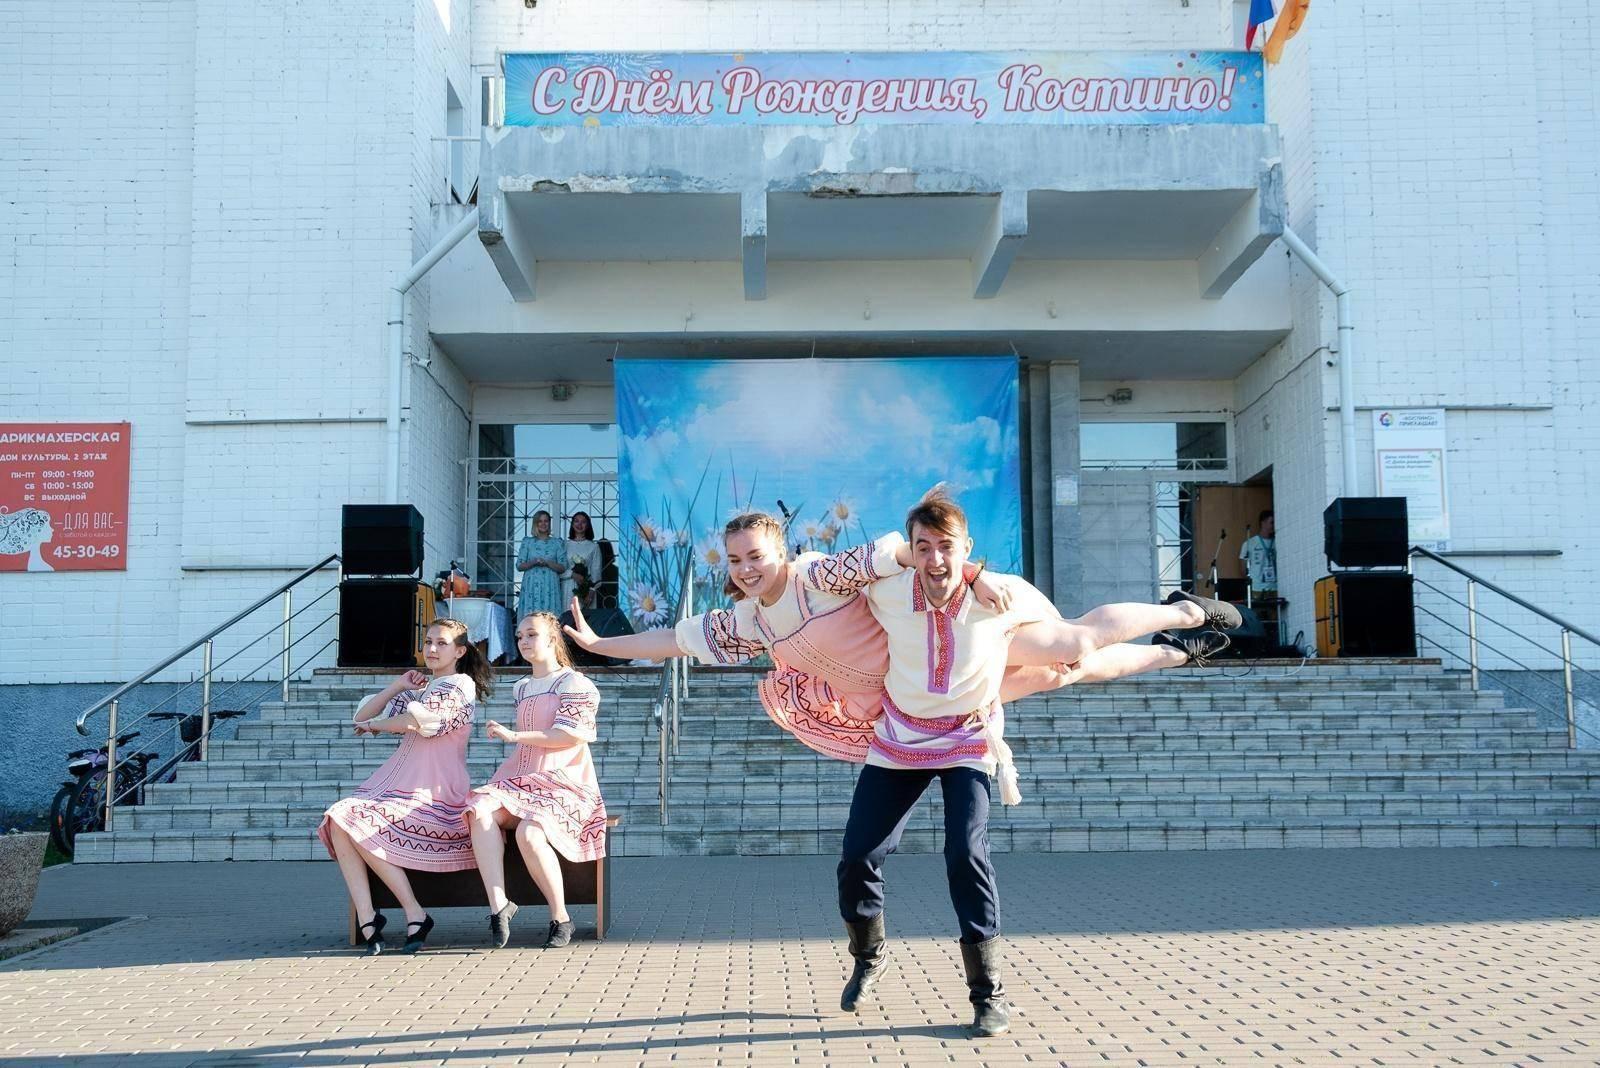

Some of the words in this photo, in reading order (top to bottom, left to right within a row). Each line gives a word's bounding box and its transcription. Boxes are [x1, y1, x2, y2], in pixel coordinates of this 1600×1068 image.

[533, 66, 567, 114] С
[571, 65, 714, 114] Днём
[722, 65, 988, 125] Рождения,
[998, 64, 1237, 112] Костино!
[0, 432, 120, 443] АРИКМАХЕРСКАЯ
[0, 454, 18, 462] ДОМ
[82, 453, 108, 461] ЭТАЖ
[42, 470, 65, 478] 09:00
[72, 470, 95, 478] 19:00
[42, 482, 65, 490] 10:00
[72, 481, 94, 489] 15:00
[53, 545, 120, 558] 45-30-49
